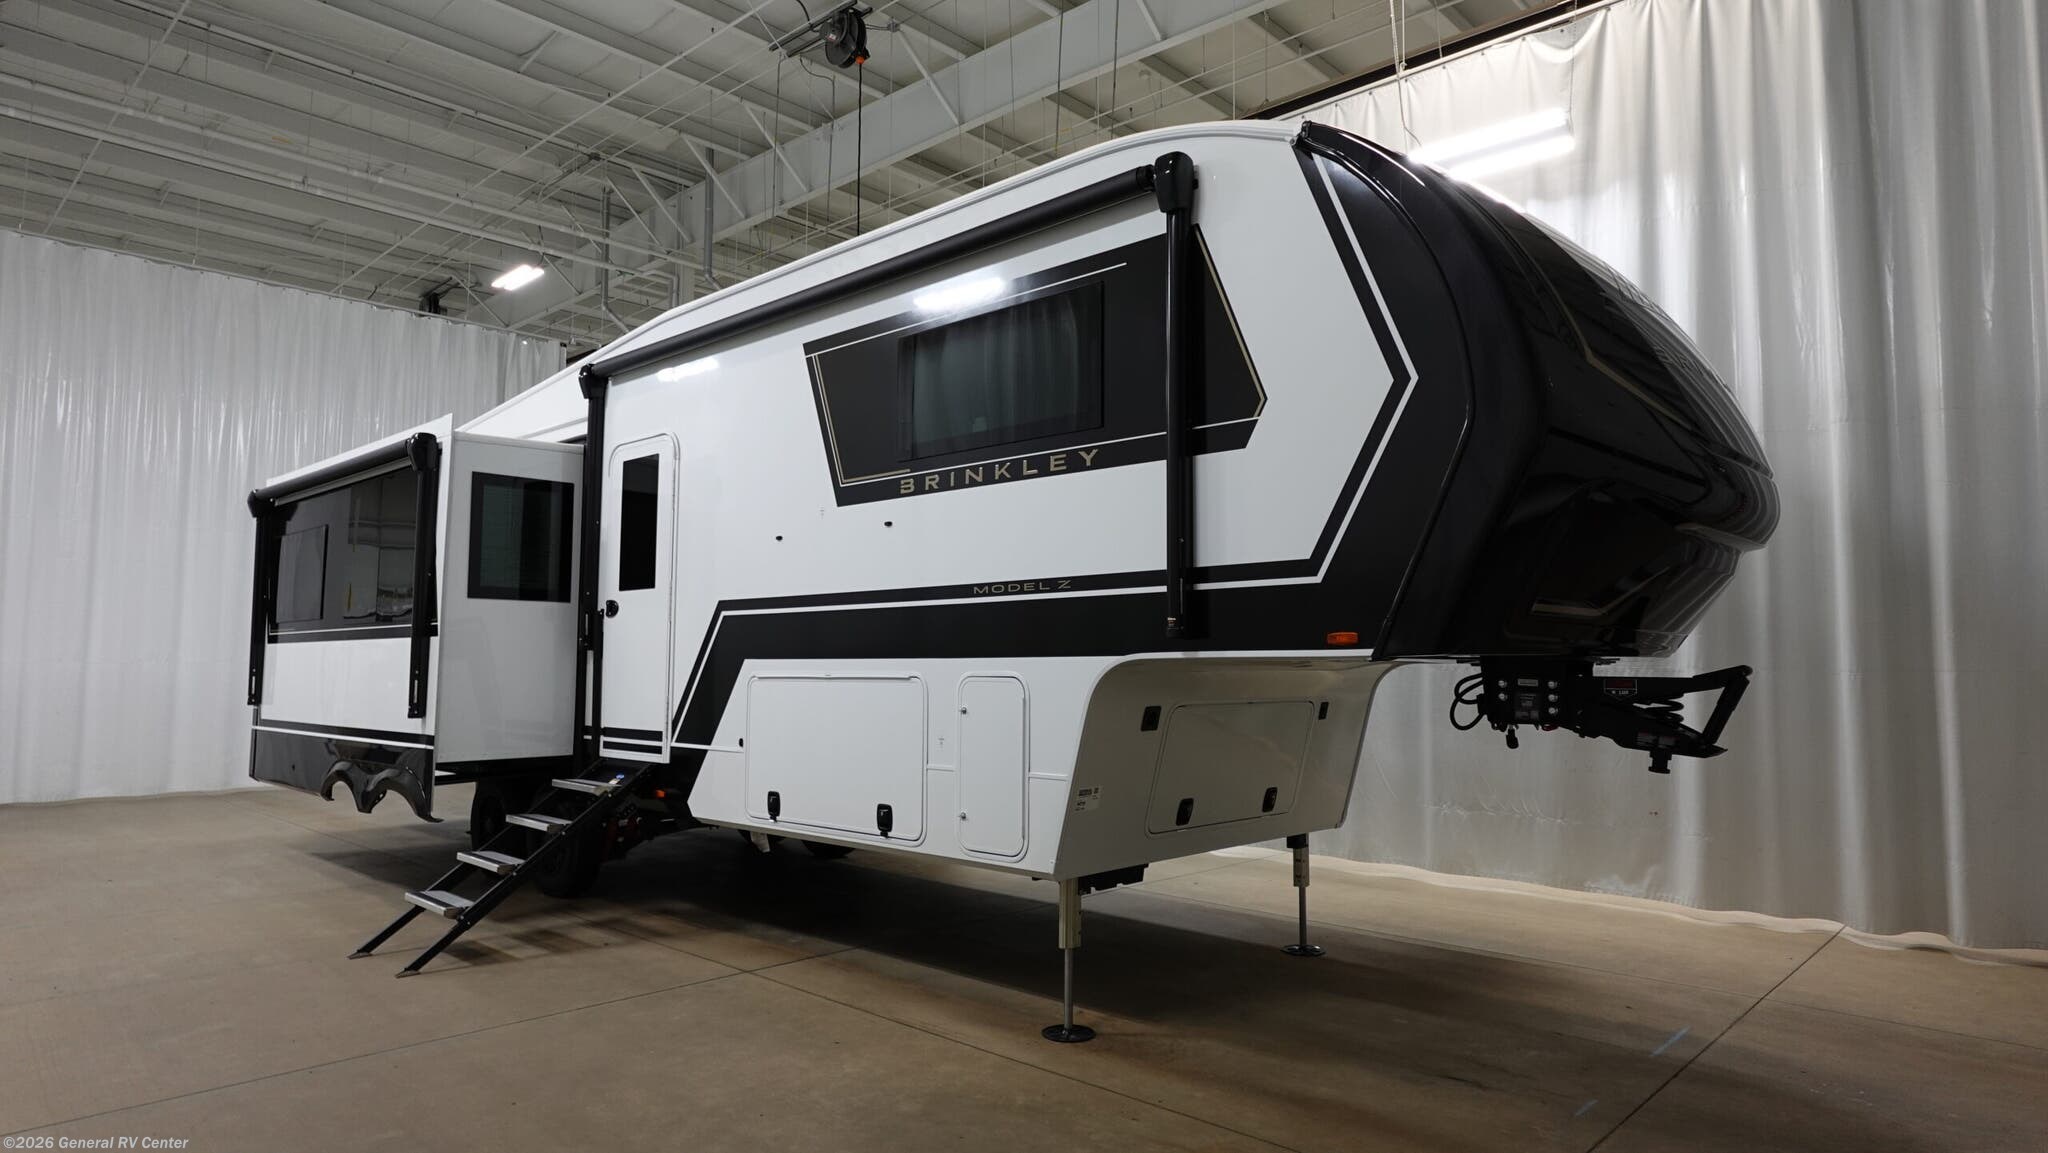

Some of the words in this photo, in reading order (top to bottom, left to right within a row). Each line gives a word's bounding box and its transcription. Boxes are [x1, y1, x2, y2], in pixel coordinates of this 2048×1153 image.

[900, 449, 1098, 494] BRINKLEY
[973, 582, 1050, 595] MODEL
[1057, 579, 1072, 589] Z
